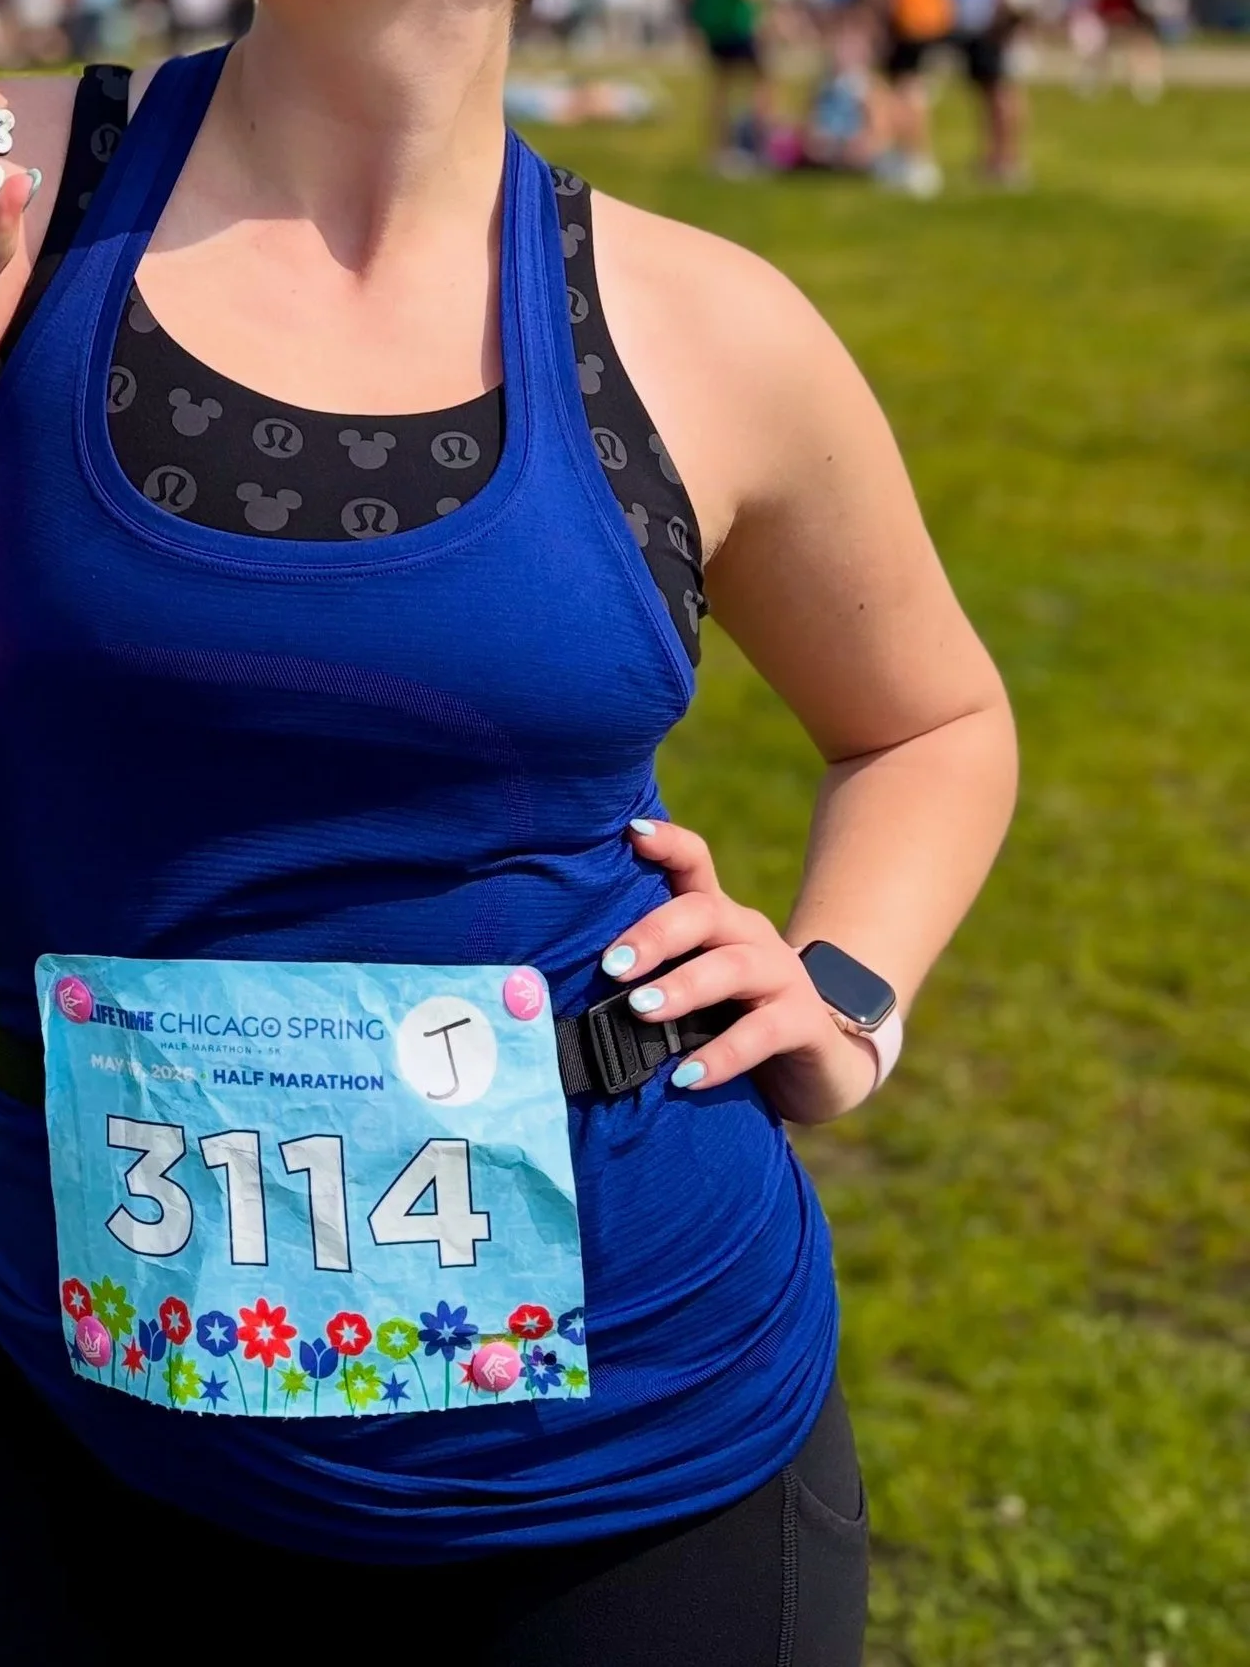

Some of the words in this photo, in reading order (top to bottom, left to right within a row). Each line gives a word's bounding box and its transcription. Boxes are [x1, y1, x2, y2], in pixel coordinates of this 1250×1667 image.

[160, 1012, 281, 1038] CHICAGO
[287, 1017, 385, 1041] SPRING
[160, 1042, 188, 1051] HALF
[191, 1043, 251, 1054] MARATHON
[423, 1017, 471, 1100] J
[91, 1053, 124, 1072] MAY
[213, 1069, 263, 1086] HALF
[269, 1071, 384, 1091] MARATHON
[105, 1113, 491, 1274] 3114
